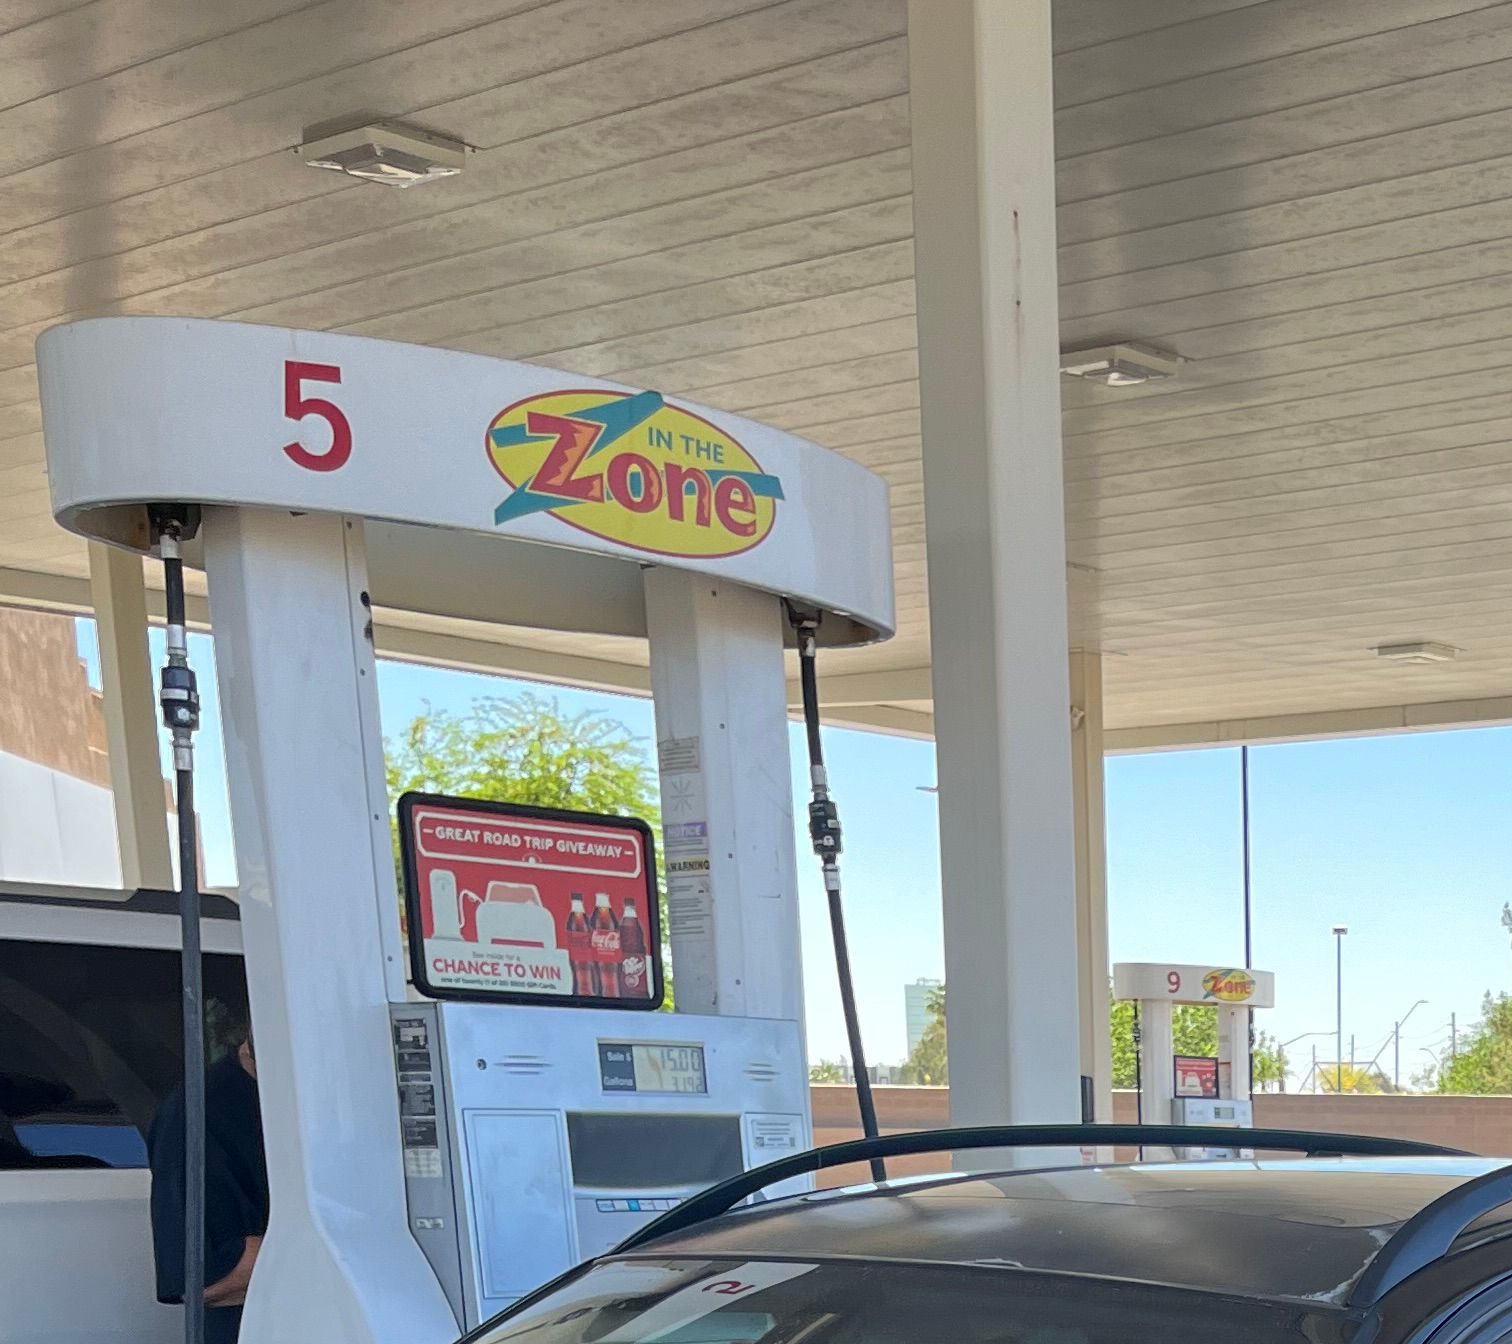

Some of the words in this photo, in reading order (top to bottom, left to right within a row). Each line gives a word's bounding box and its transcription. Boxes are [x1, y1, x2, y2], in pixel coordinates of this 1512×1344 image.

[283, 360, 353, 472] 5
[648, 426, 673, 451] IN
[679, 434, 725, 464] THE
[526, 411, 758, 538] Zone
[435, 825, 481, 843] GREAT
[483, 831, 521, 848] ROAD
[524, 836, 553, 850] TRIP
[555, 839, 623, 858] GIVEAWAY
[432, 959, 501, 977] CHANCE
[504, 963, 526, 978] TO
[530, 965, 561, 980] WIN
[1167, 971, 1180, 993] 9
